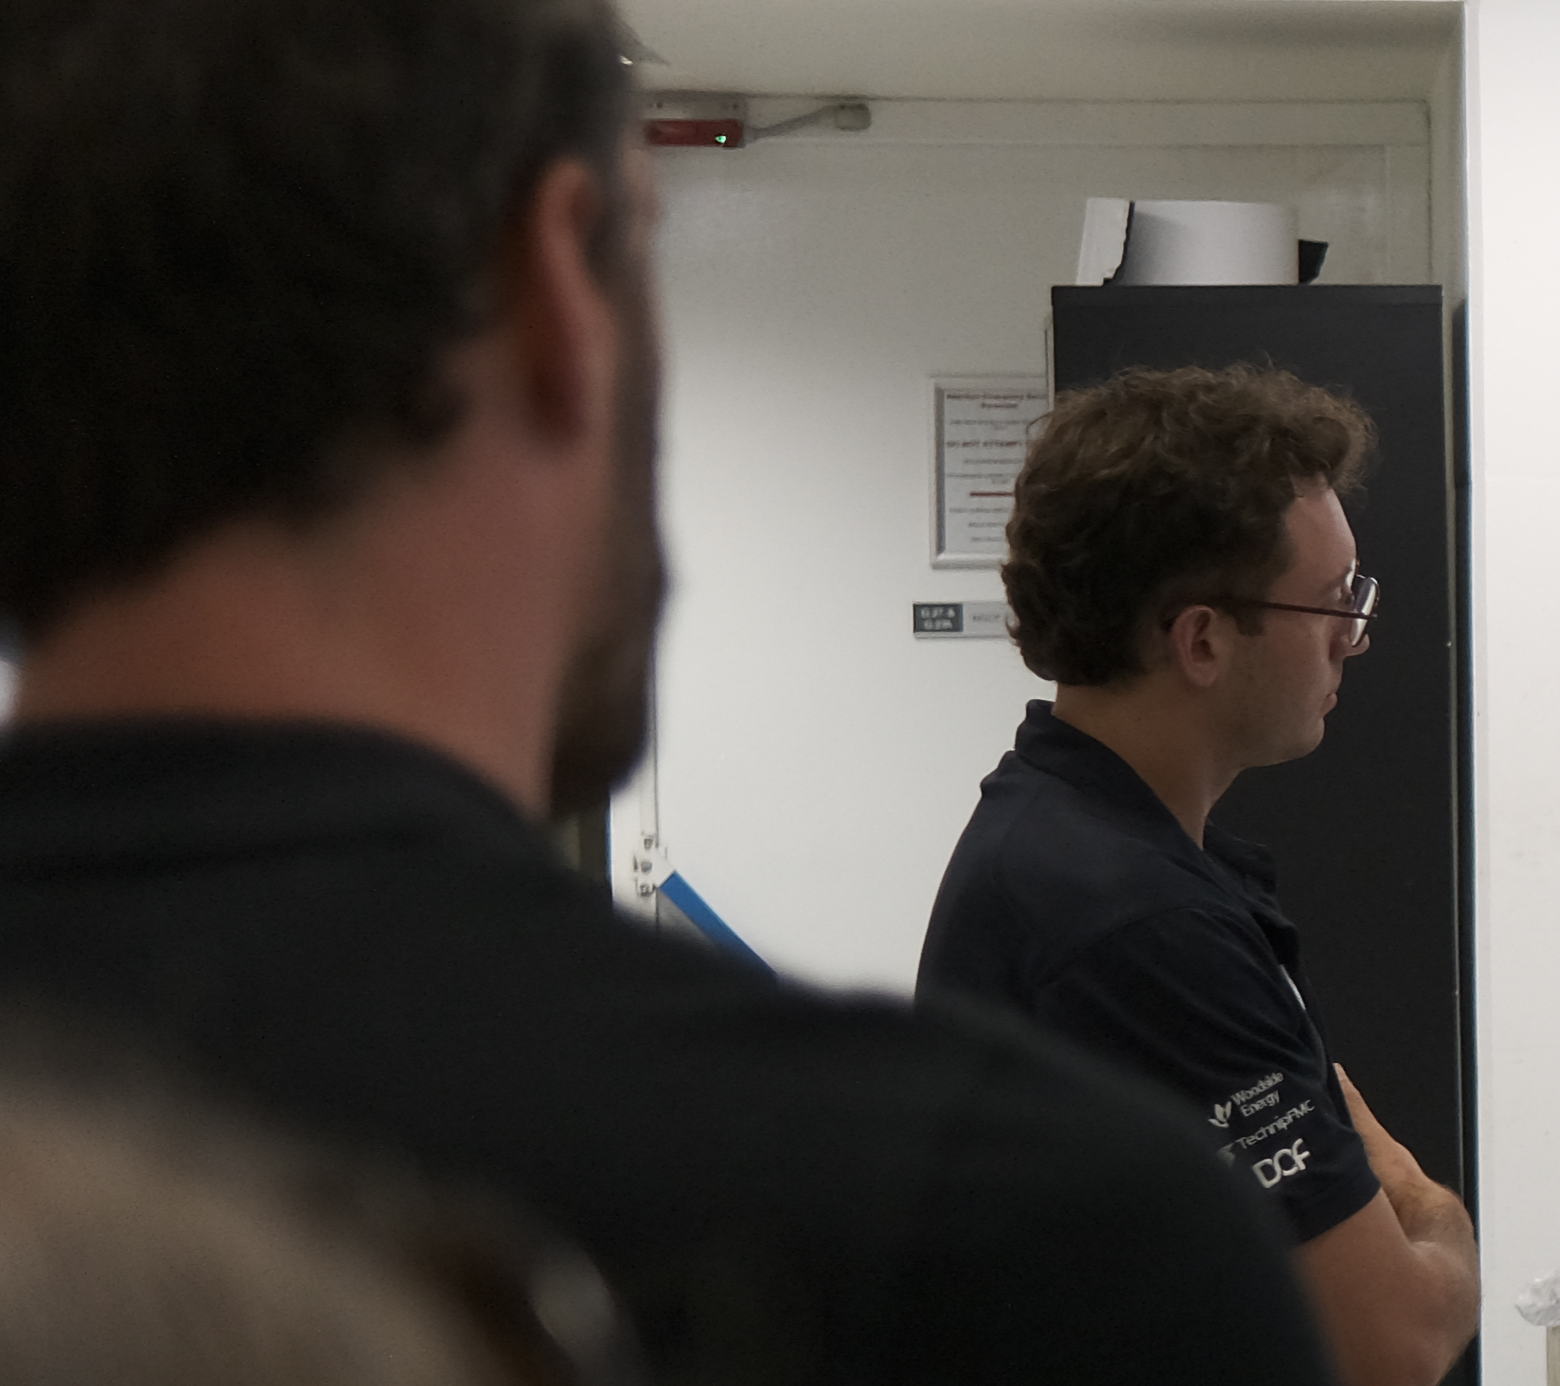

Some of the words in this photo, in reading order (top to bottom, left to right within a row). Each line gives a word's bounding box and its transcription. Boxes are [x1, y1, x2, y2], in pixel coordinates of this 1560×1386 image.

[1231, 1071, 1284, 1106] Woodside
[1240, 1090, 1281, 1117] Energy
[1236, 1099, 1316, 1151] TechnipFMC
